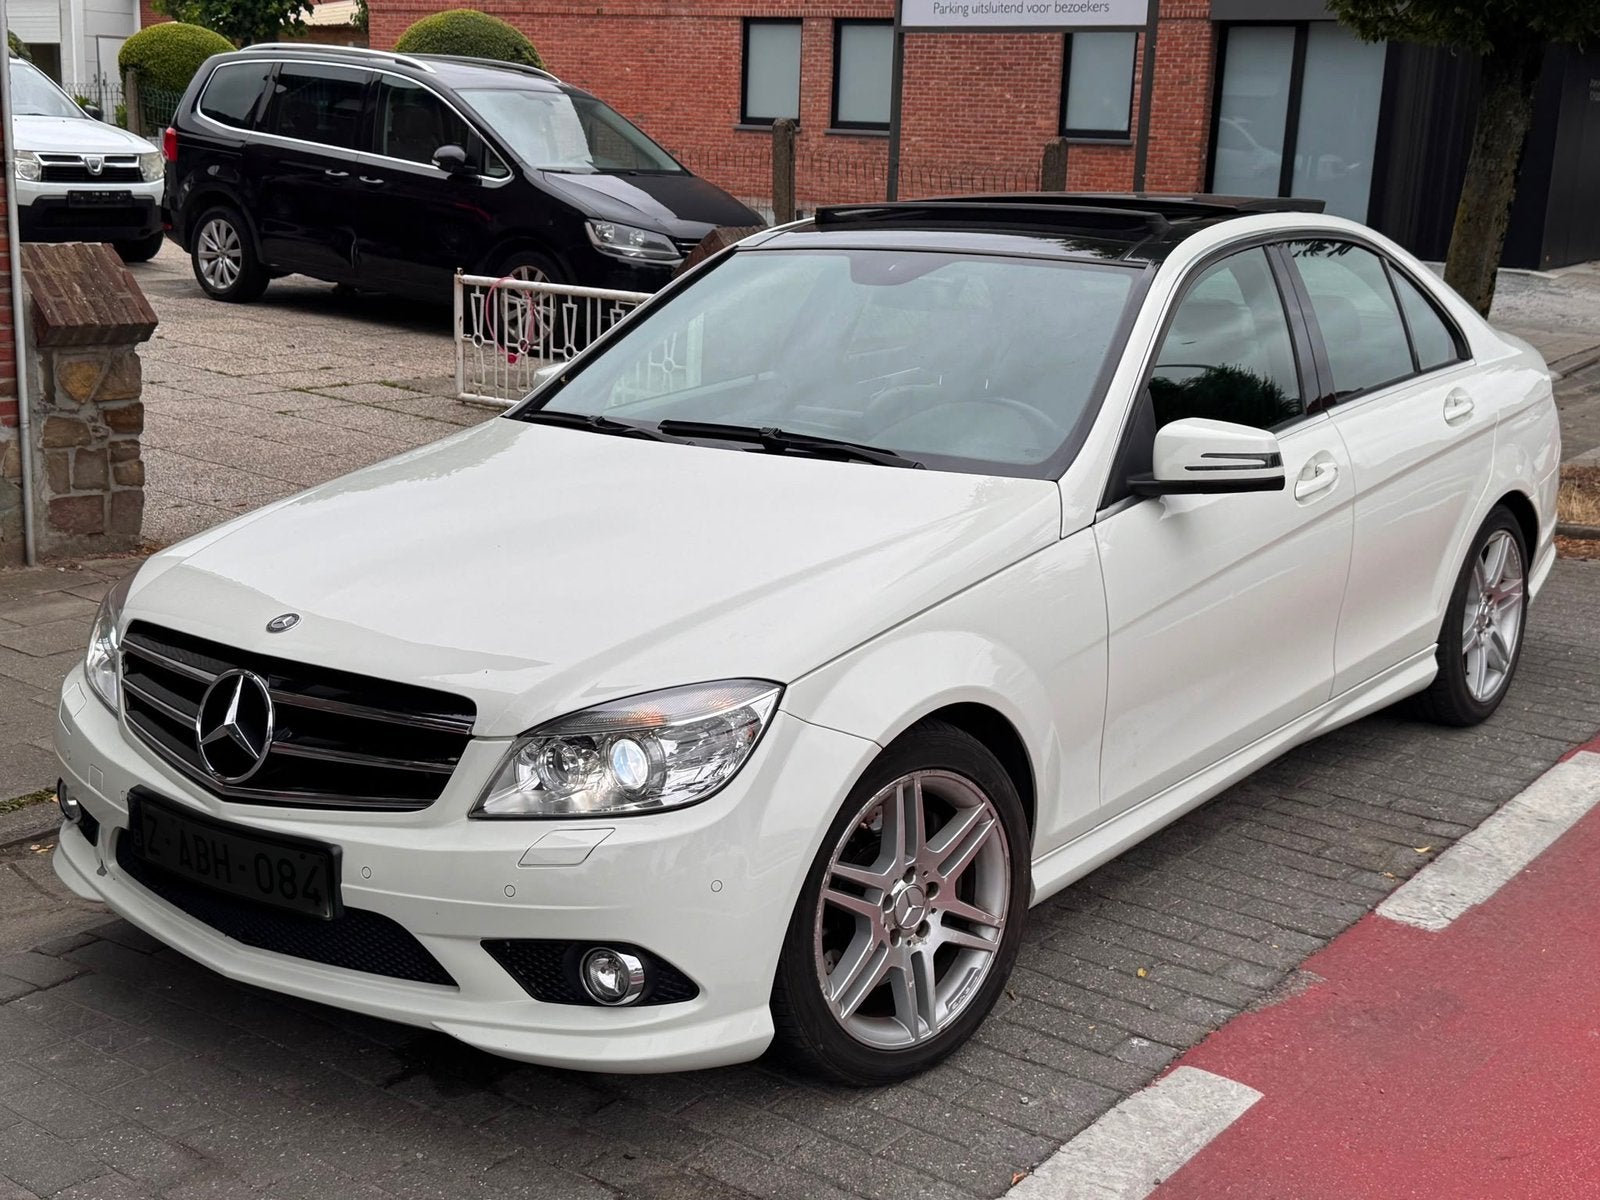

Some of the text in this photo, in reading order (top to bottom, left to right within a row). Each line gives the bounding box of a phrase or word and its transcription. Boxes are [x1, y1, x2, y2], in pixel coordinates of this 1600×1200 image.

[933, 1, 1110, 17] Parking uitsluitend voor bezoekers
